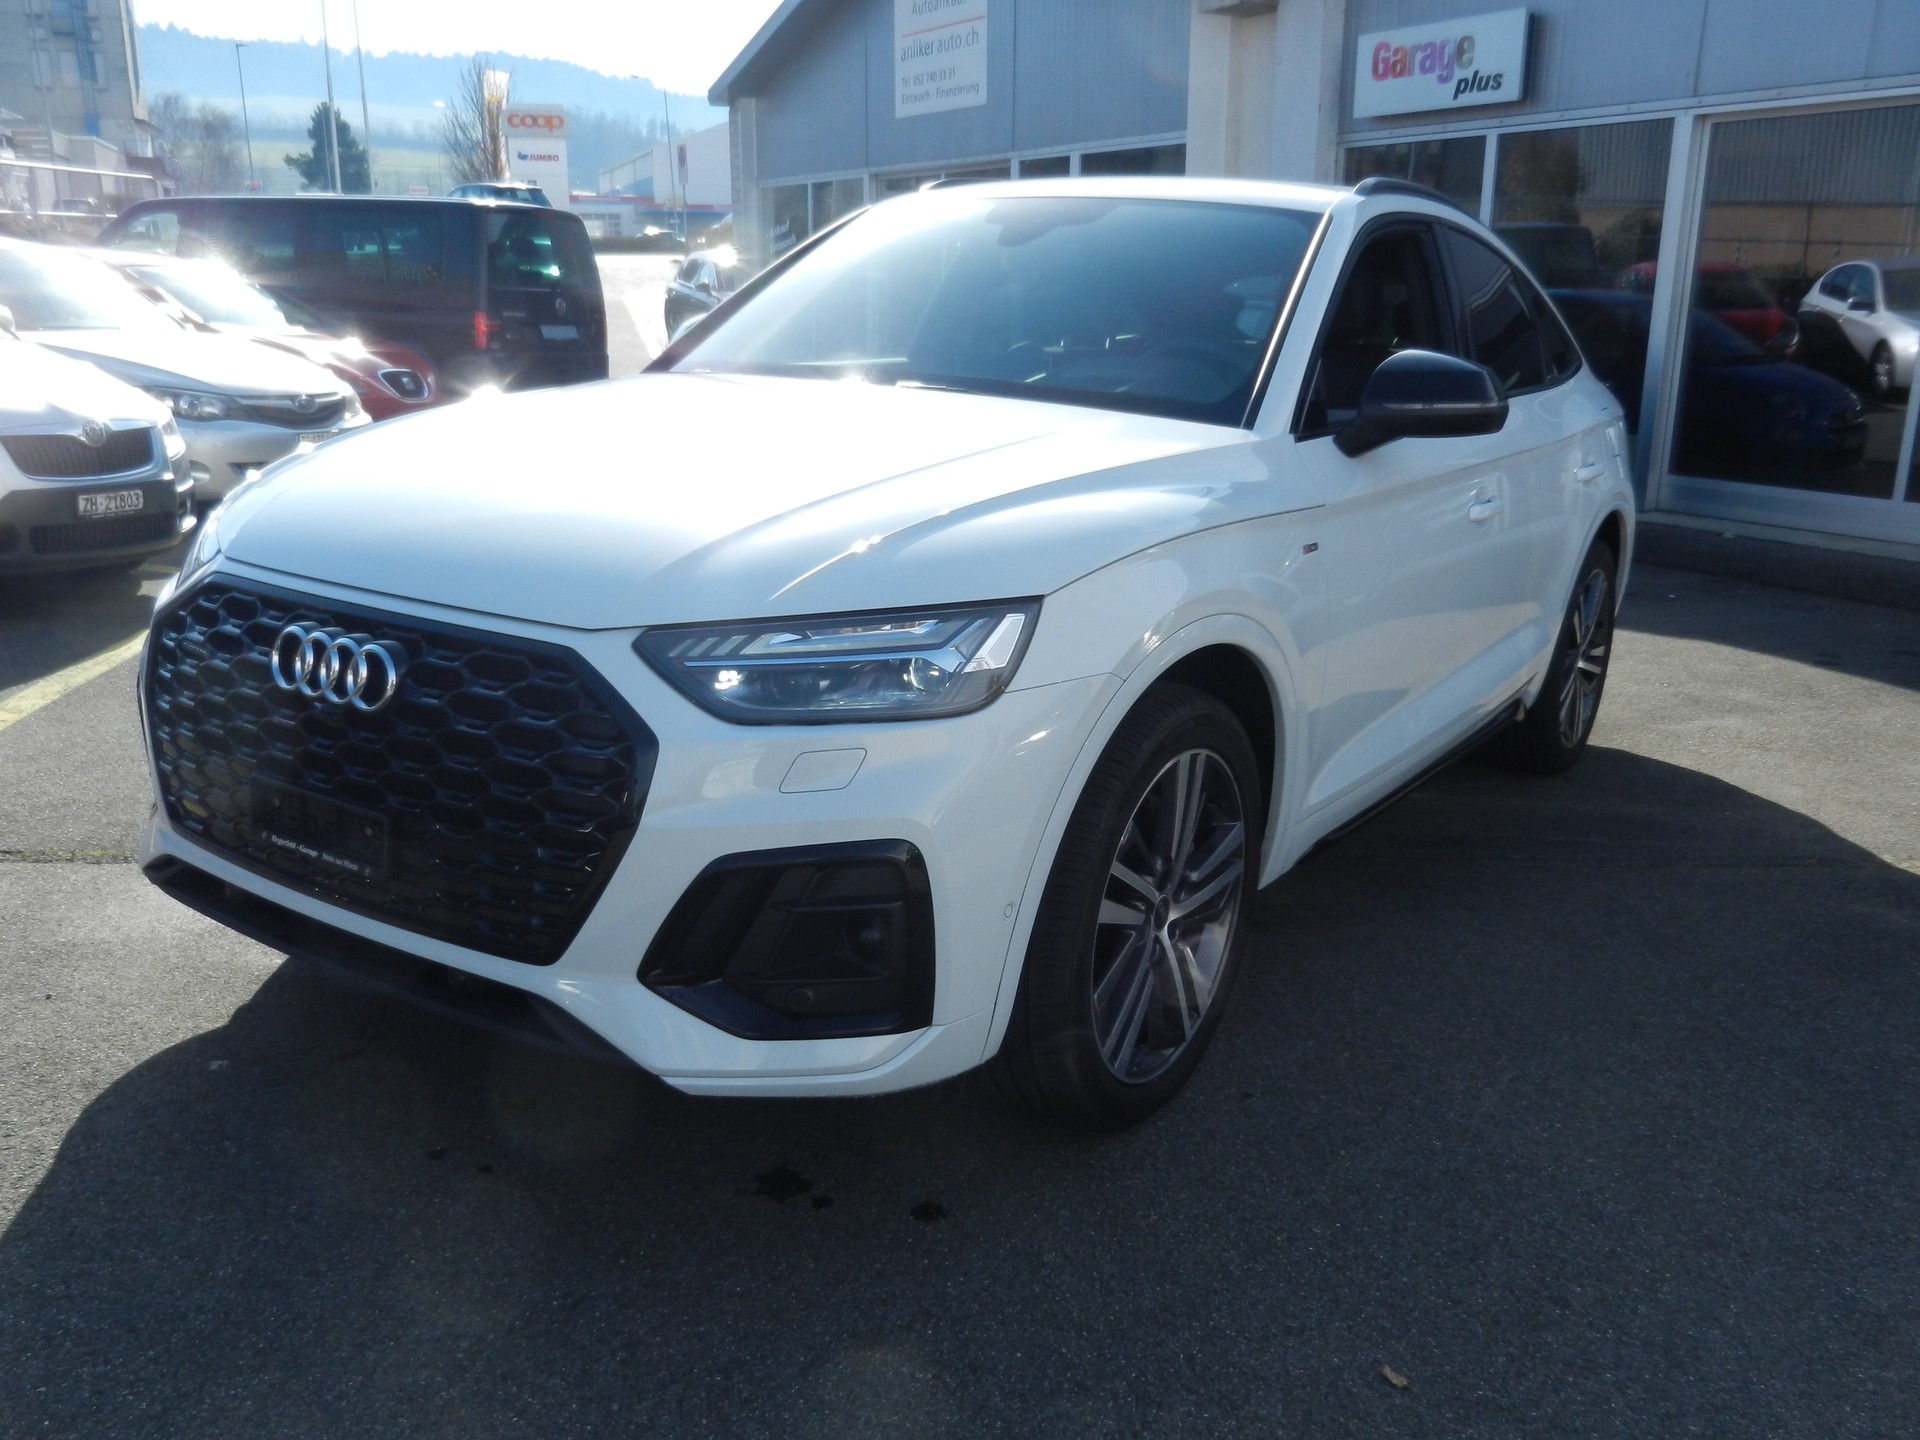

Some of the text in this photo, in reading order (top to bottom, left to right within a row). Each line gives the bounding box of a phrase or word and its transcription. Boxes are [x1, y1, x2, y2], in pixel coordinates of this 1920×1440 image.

[1372, 35, 1475, 84] Garage
[936, 83, 979, 99] Finanzierung
[1452, 70, 1503, 100] plus
[507, 113, 564, 133] coop
[528, 153, 559, 162] JUMBO
